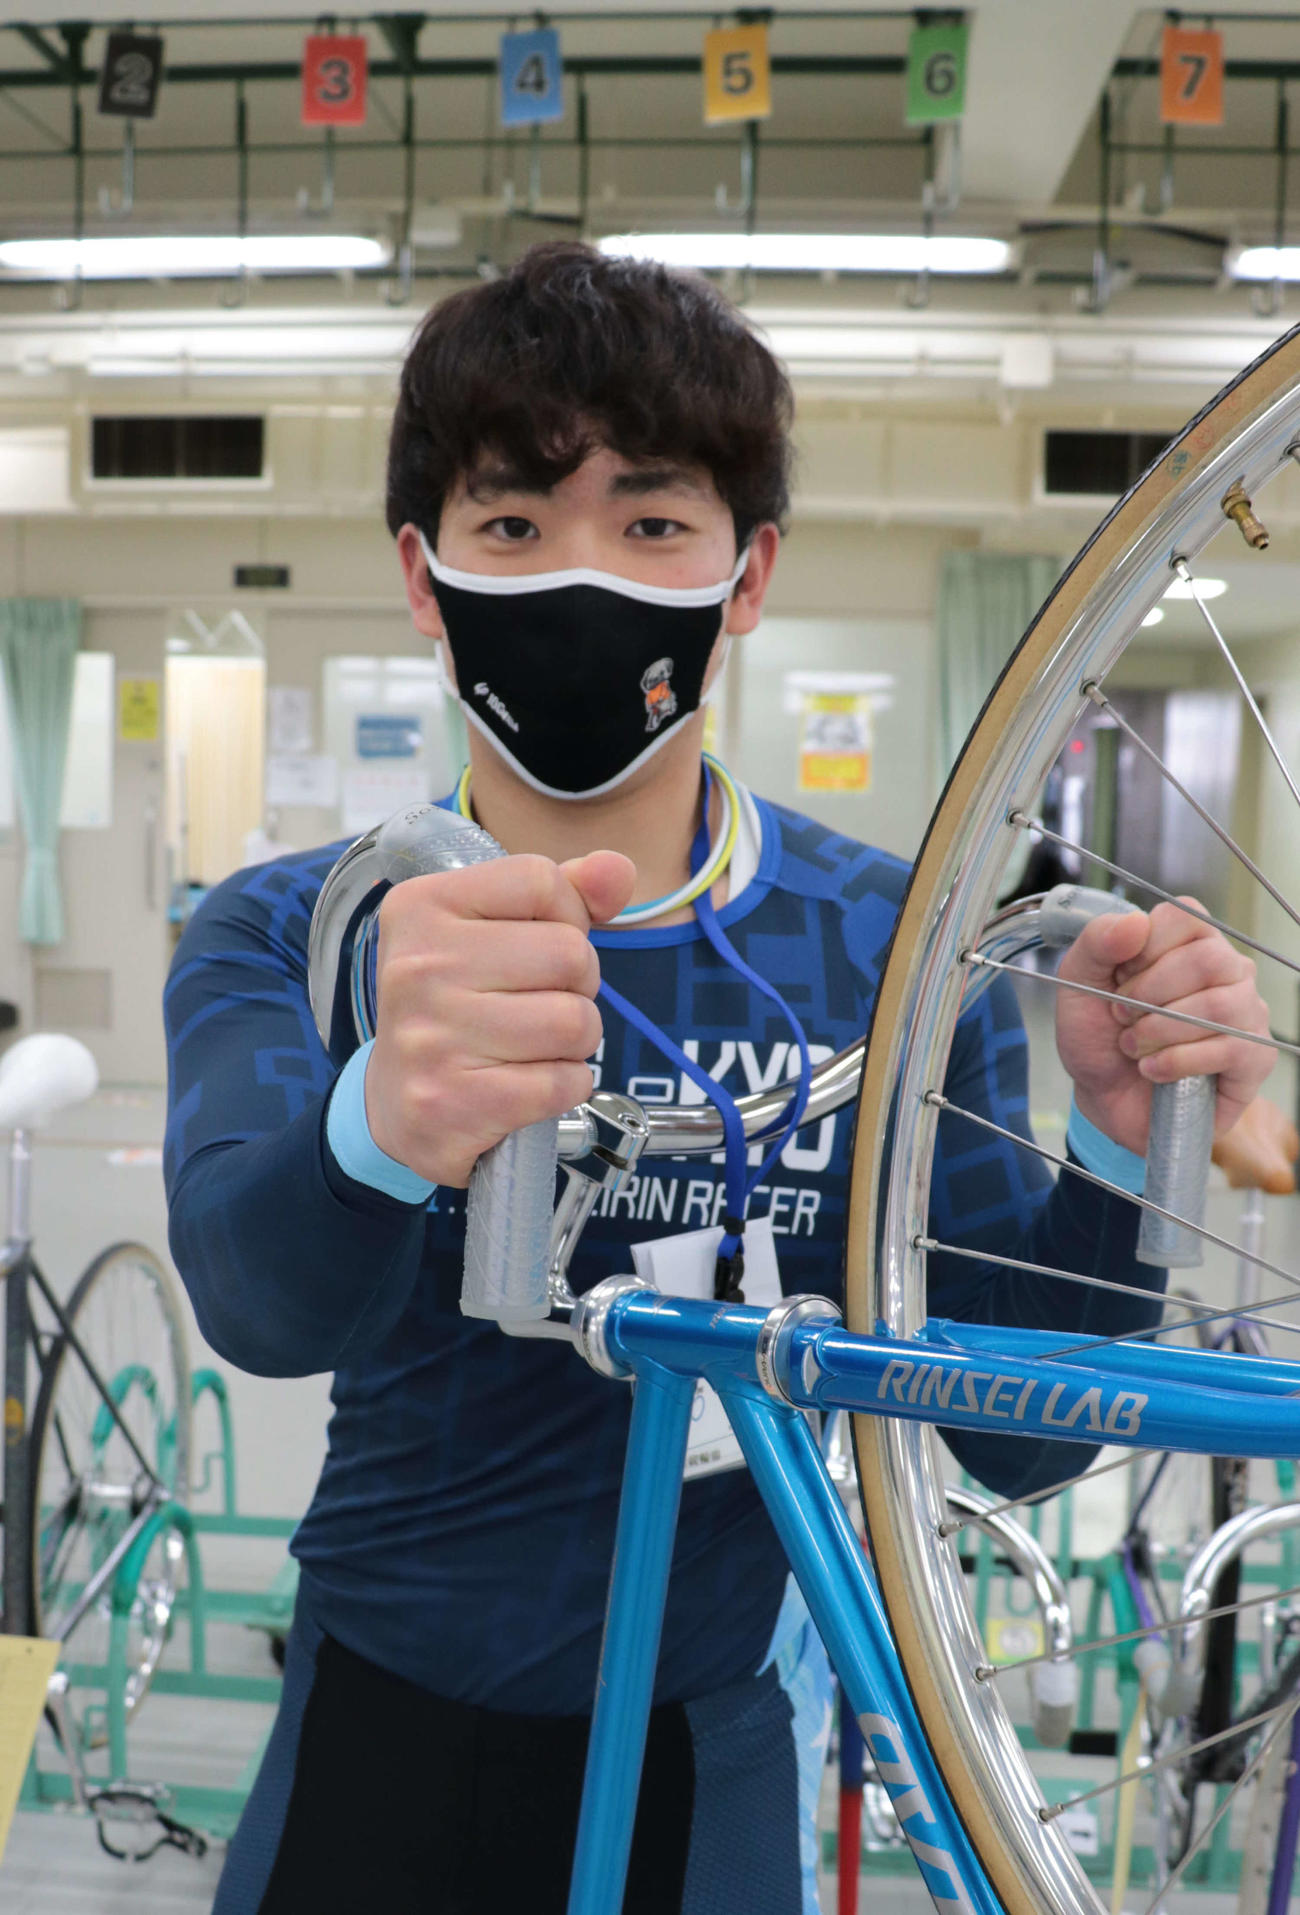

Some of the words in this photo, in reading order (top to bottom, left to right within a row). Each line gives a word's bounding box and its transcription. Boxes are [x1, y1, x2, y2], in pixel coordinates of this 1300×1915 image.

[110, 52, 153, 104] 2
[319, 57, 354, 103] 3
[515, 53, 547, 96] 4
[722, 52, 754, 95] 5
[925, 51, 957, 96] 6
[1180, 54, 1207, 99] 7
[590, 1174, 678, 1222] IRIN
[1041, 1382, 1149, 1436] LAB
